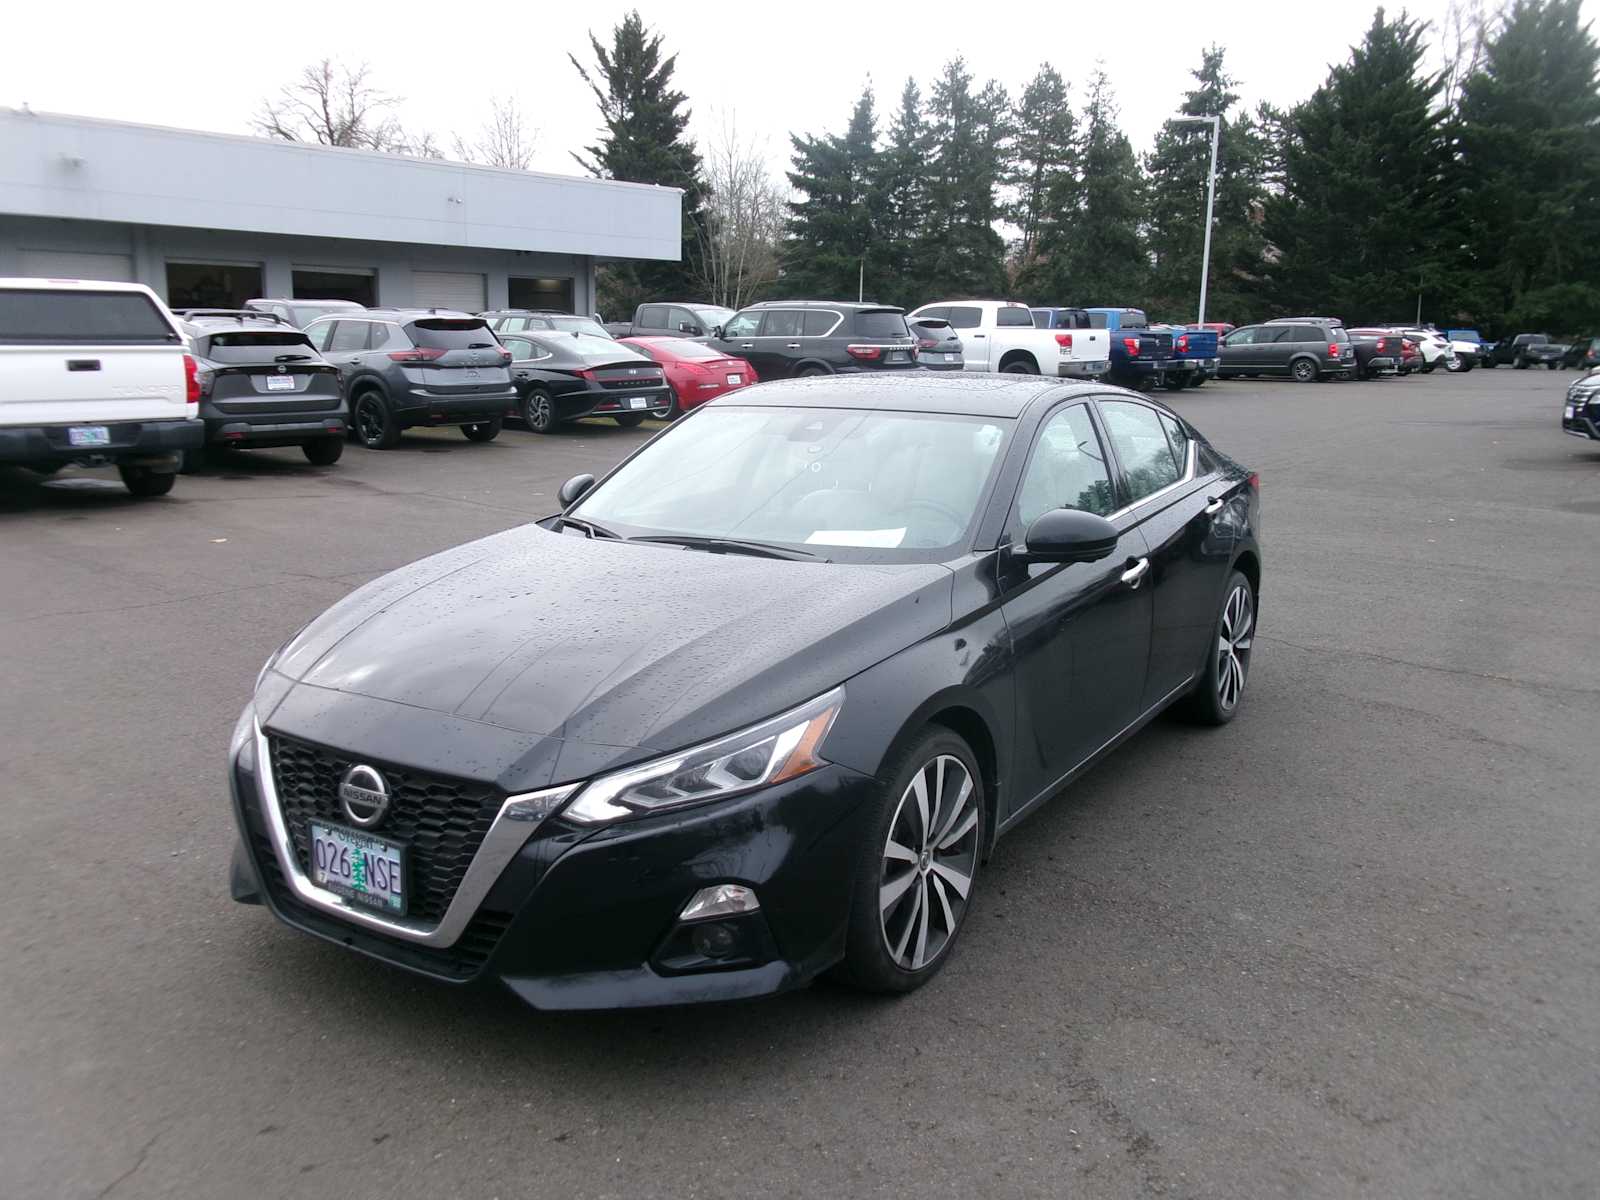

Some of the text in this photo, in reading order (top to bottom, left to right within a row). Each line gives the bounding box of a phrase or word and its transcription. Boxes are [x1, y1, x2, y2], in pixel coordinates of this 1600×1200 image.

[343, 787, 382, 806] NISSAN
[315, 838, 351, 878] 026
[363, 851, 401, 896] NSE
